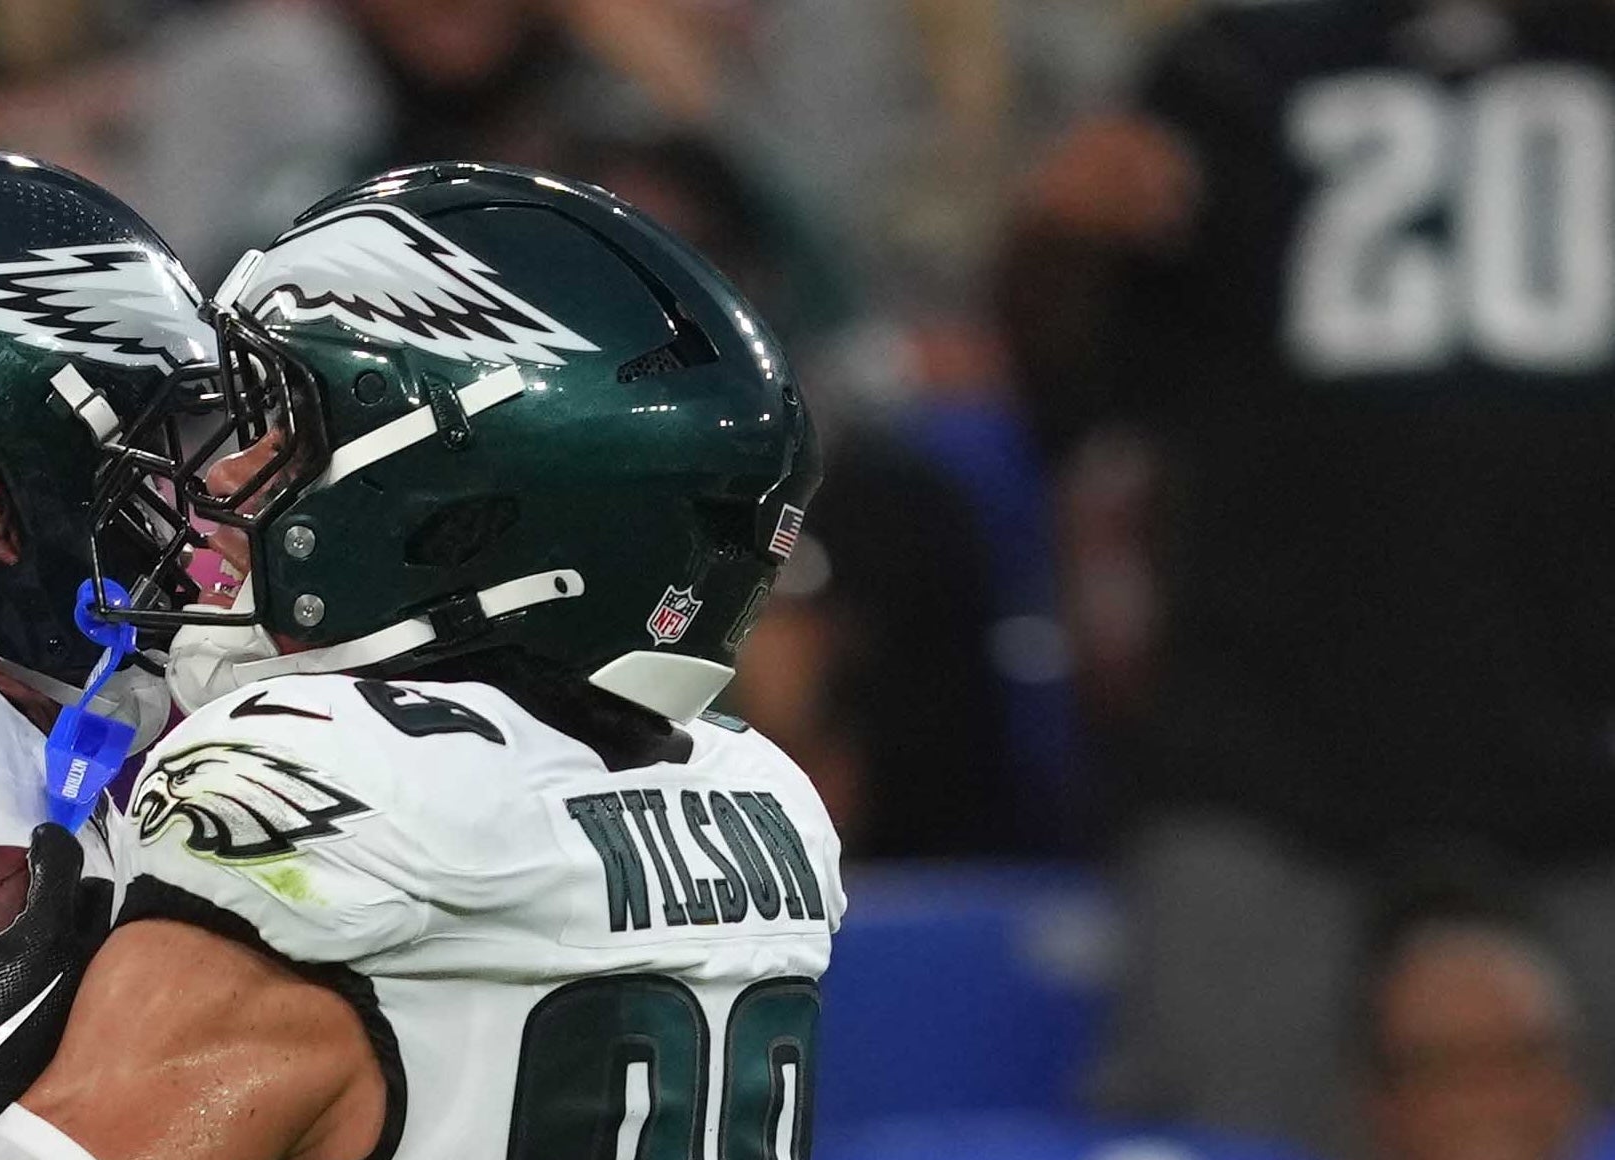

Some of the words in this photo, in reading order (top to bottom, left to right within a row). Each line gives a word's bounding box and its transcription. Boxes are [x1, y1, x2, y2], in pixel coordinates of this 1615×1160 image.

[1284, 64, 1614, 374] 20
[652, 607, 686, 636] NFL
[563, 788, 826, 933] WILSON
